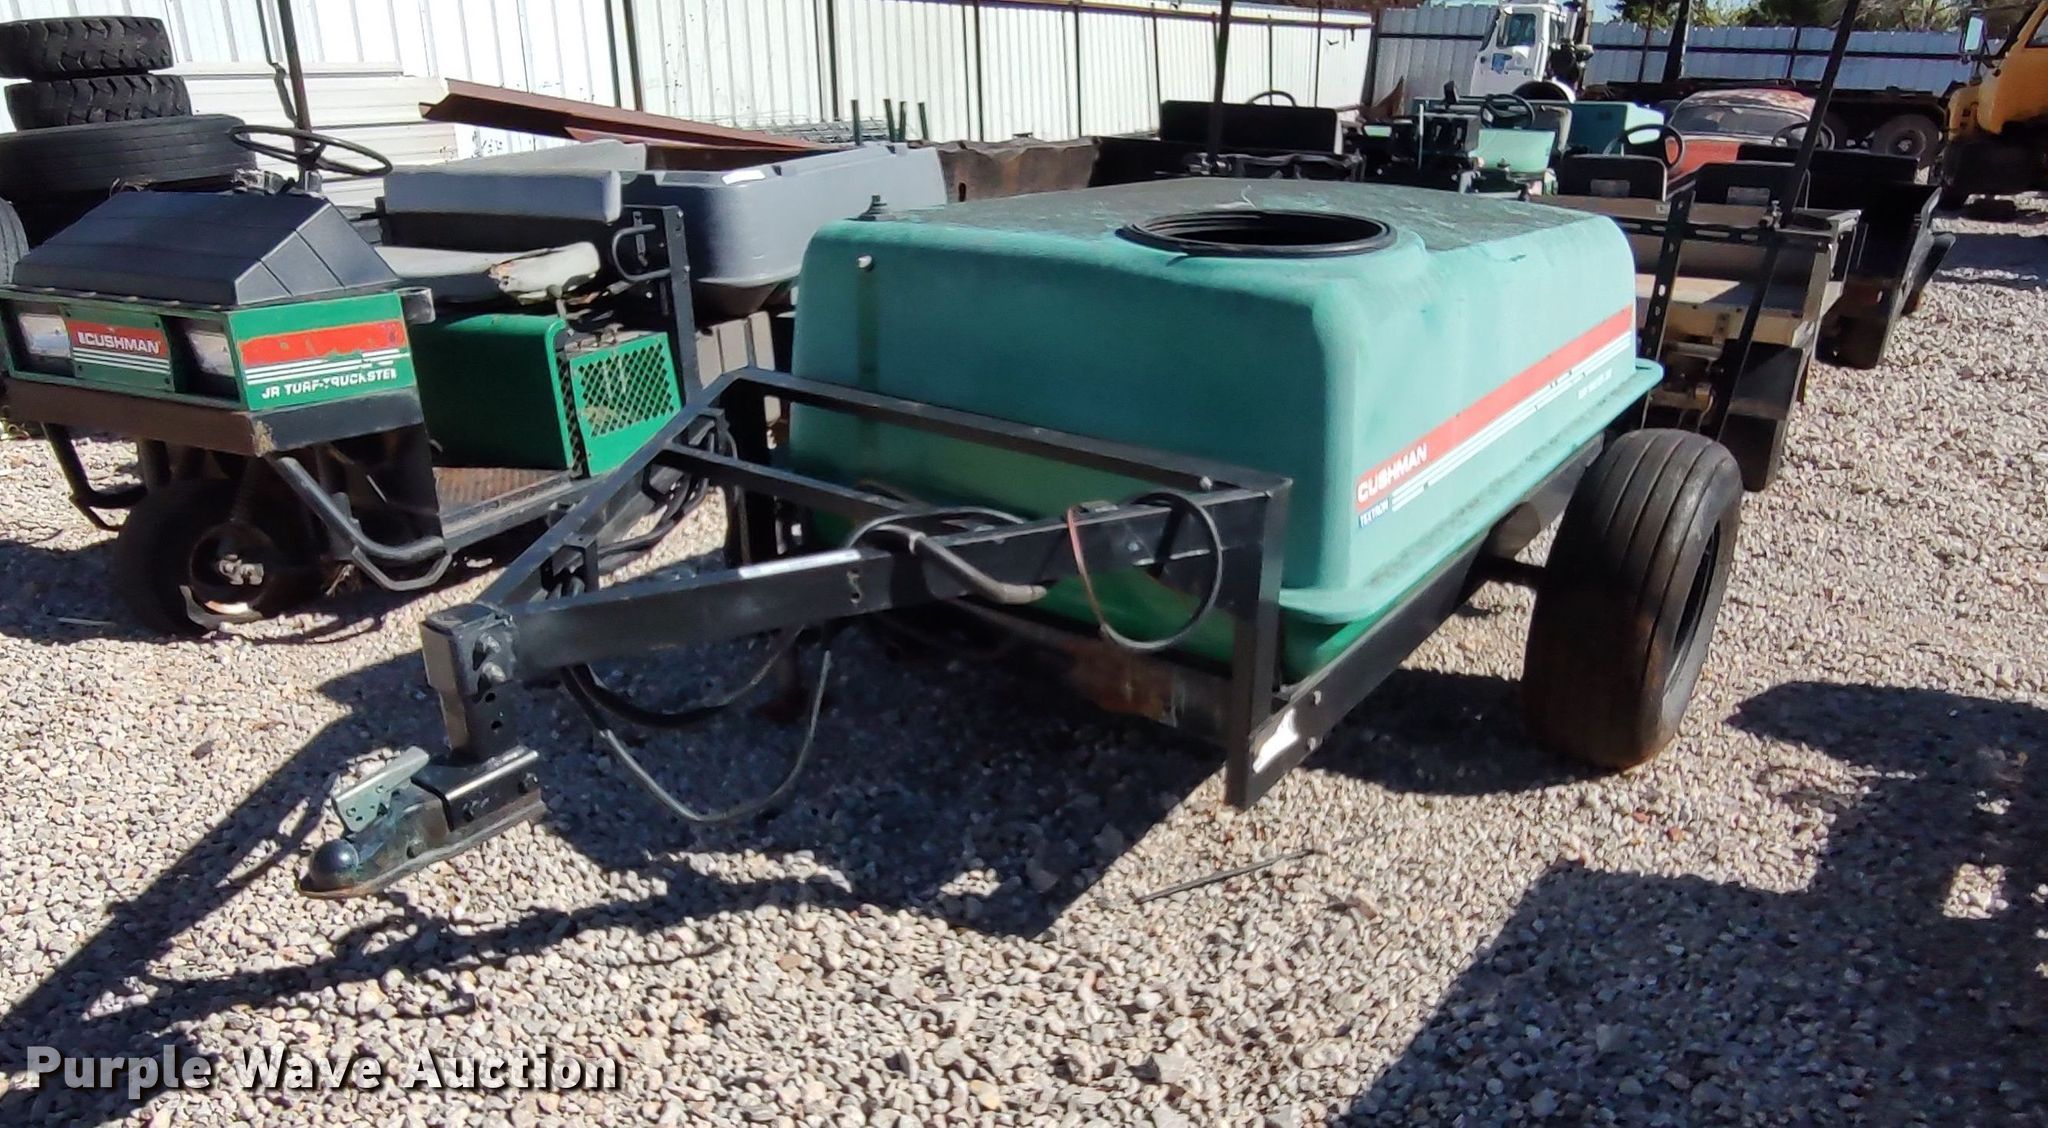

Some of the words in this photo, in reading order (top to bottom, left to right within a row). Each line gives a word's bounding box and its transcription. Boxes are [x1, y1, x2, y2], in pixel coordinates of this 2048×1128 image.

[80, 331, 160, 355] CUSHMAN
[262, 385, 280, 399] JR
[1356, 443, 1428, 503] CUSHMAN
